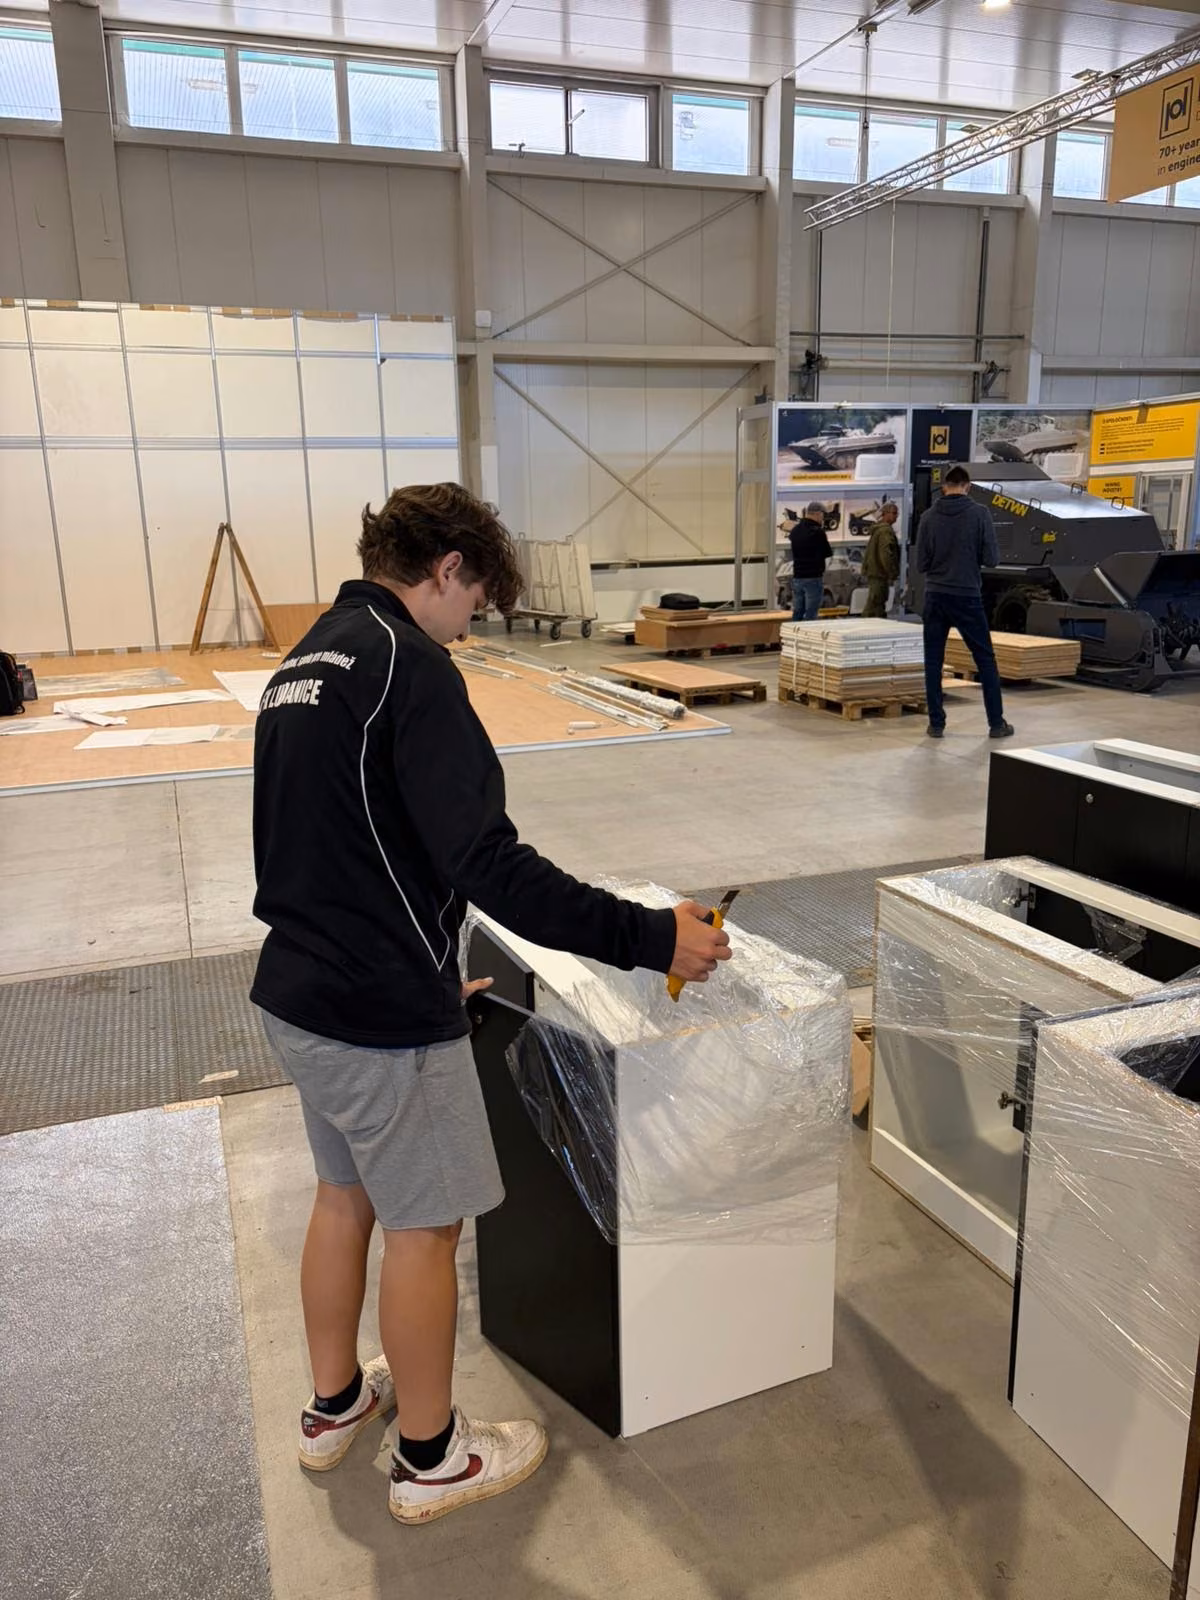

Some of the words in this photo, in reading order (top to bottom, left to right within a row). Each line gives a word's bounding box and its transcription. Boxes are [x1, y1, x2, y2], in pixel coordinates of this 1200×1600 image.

[1159, 145, 1177, 158] 70+
[1157, 166, 1166, 176] in
[320, 651, 355, 670] mládež
